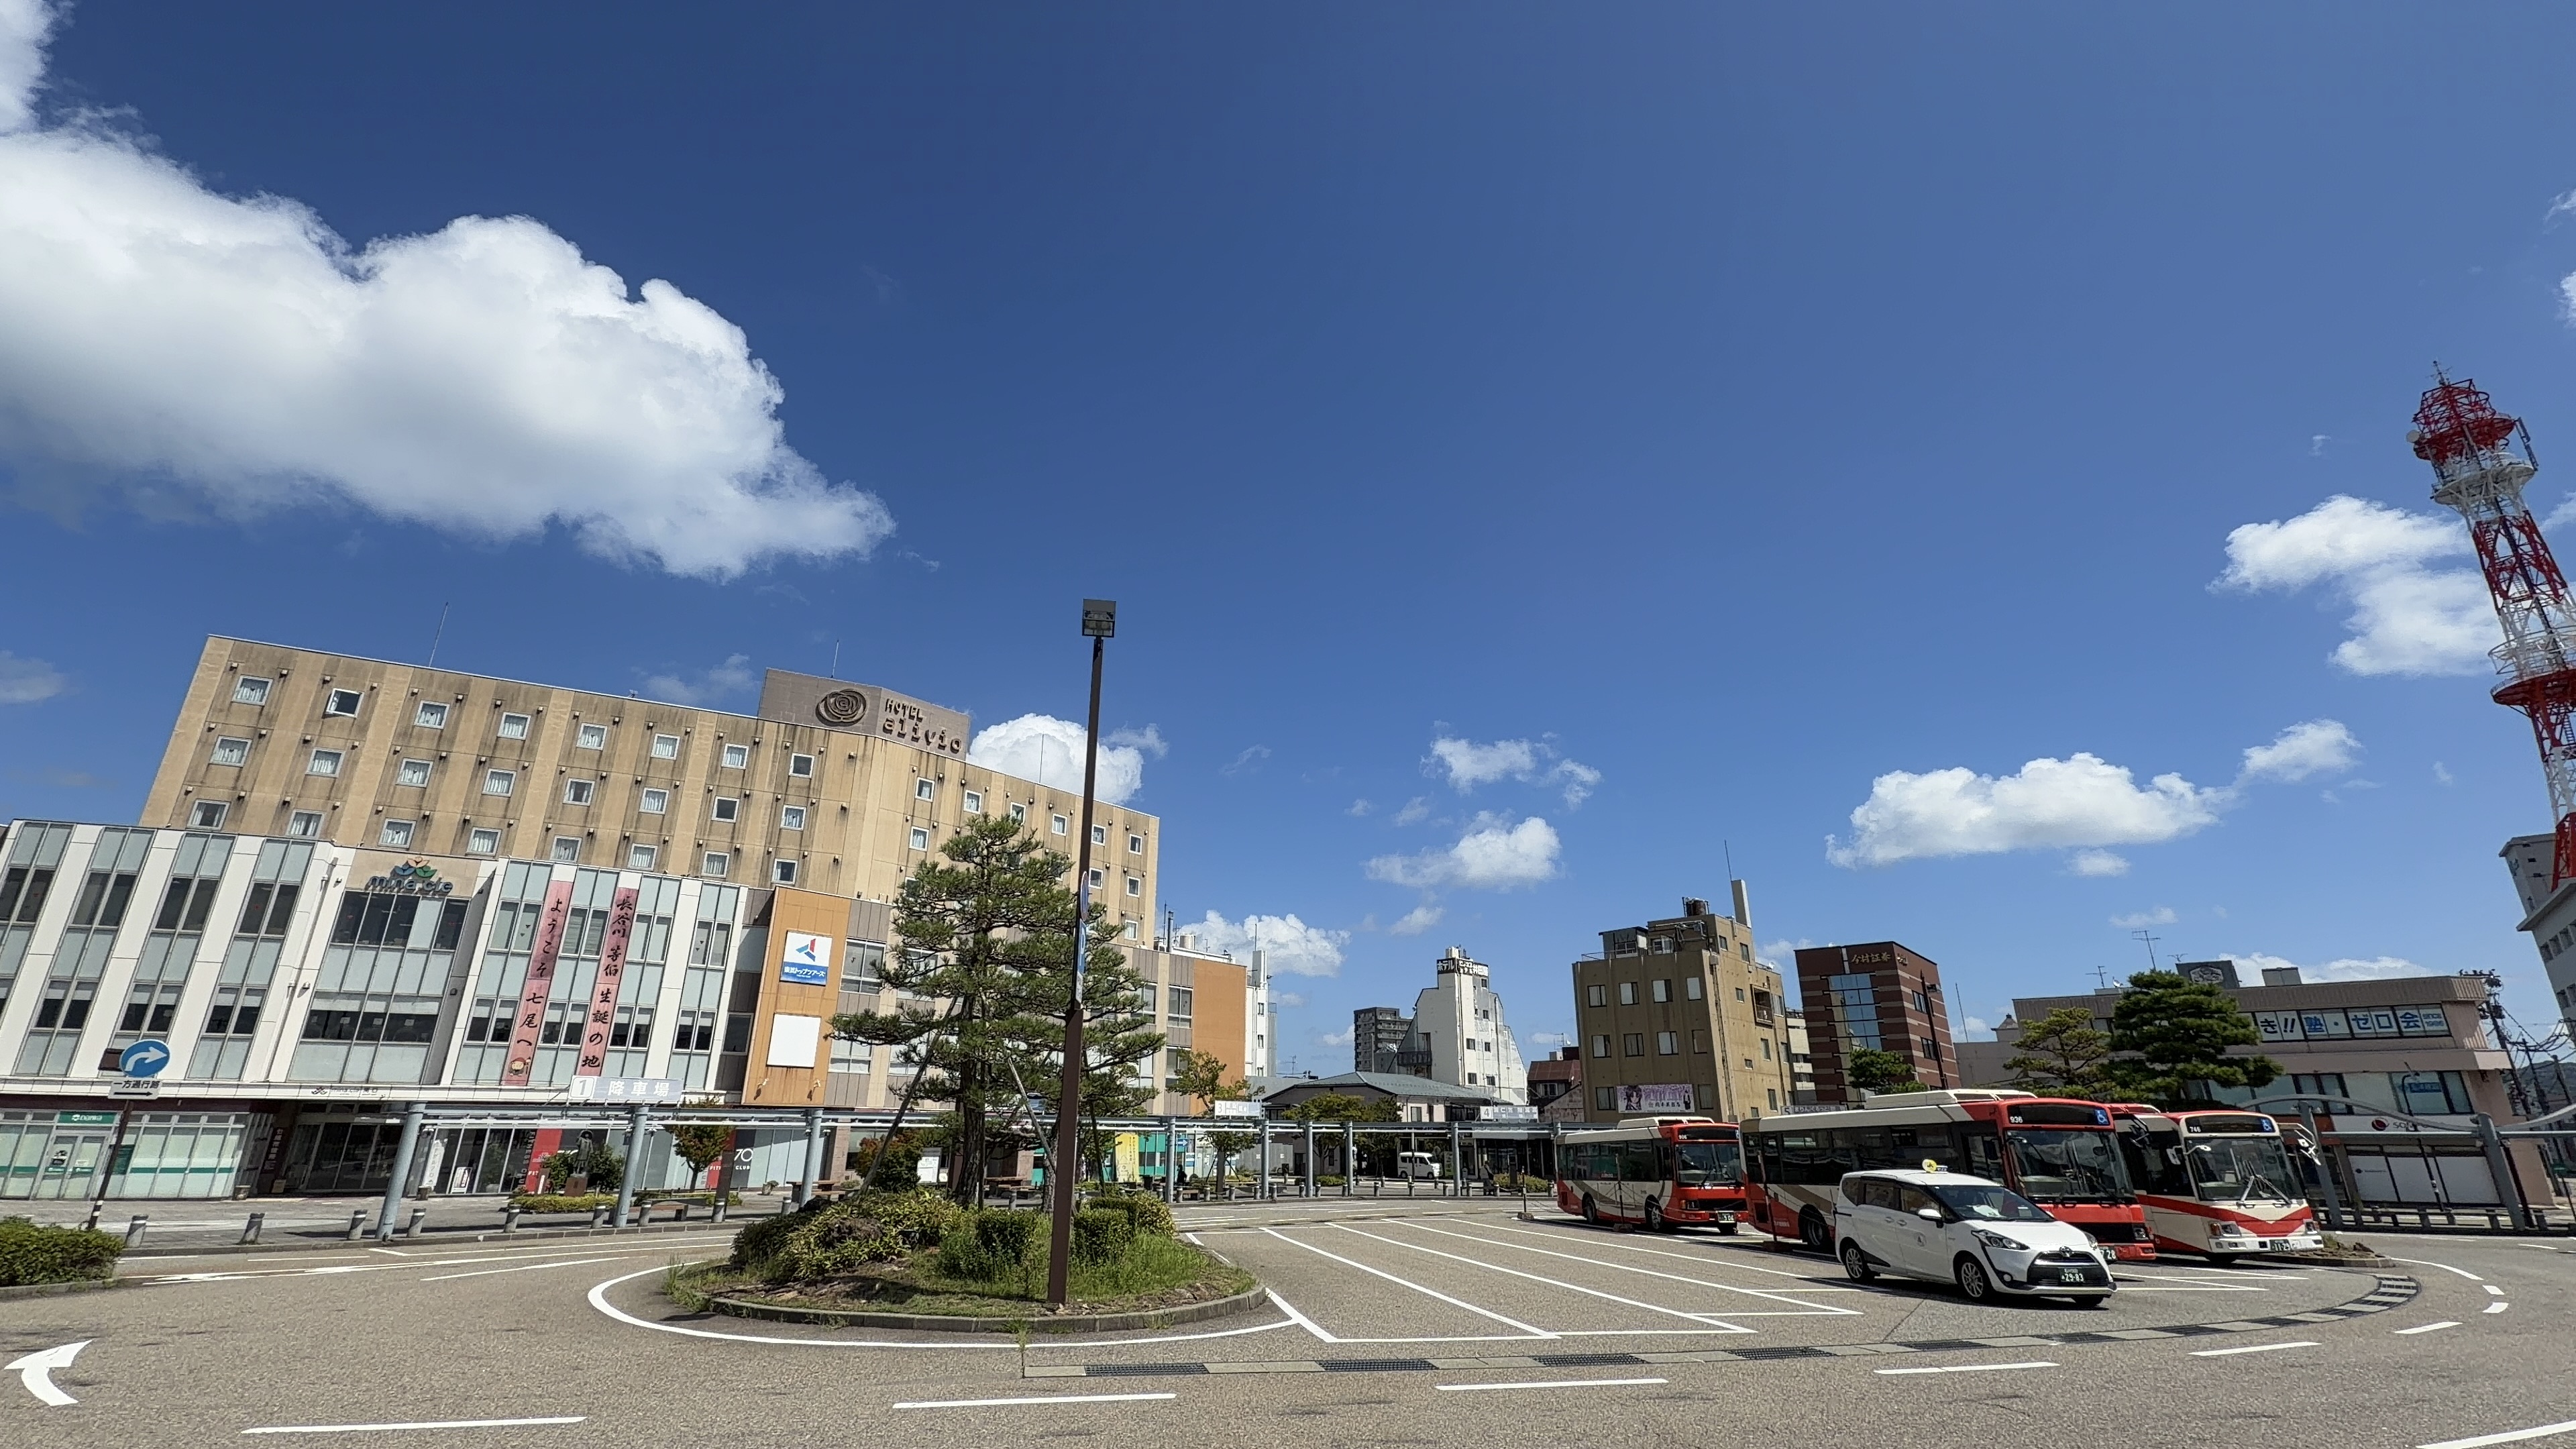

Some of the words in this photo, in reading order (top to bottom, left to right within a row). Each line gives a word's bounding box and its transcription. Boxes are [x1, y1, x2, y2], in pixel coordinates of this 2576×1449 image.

[885, 698, 924, 722] HOTEL
[883, 718, 961, 754] alivio
[113, 1080, 160, 1088] 一方通行路
[608, 1081, 670, 1097] 降車場
[1484, 1108, 1490, 1117] 4
